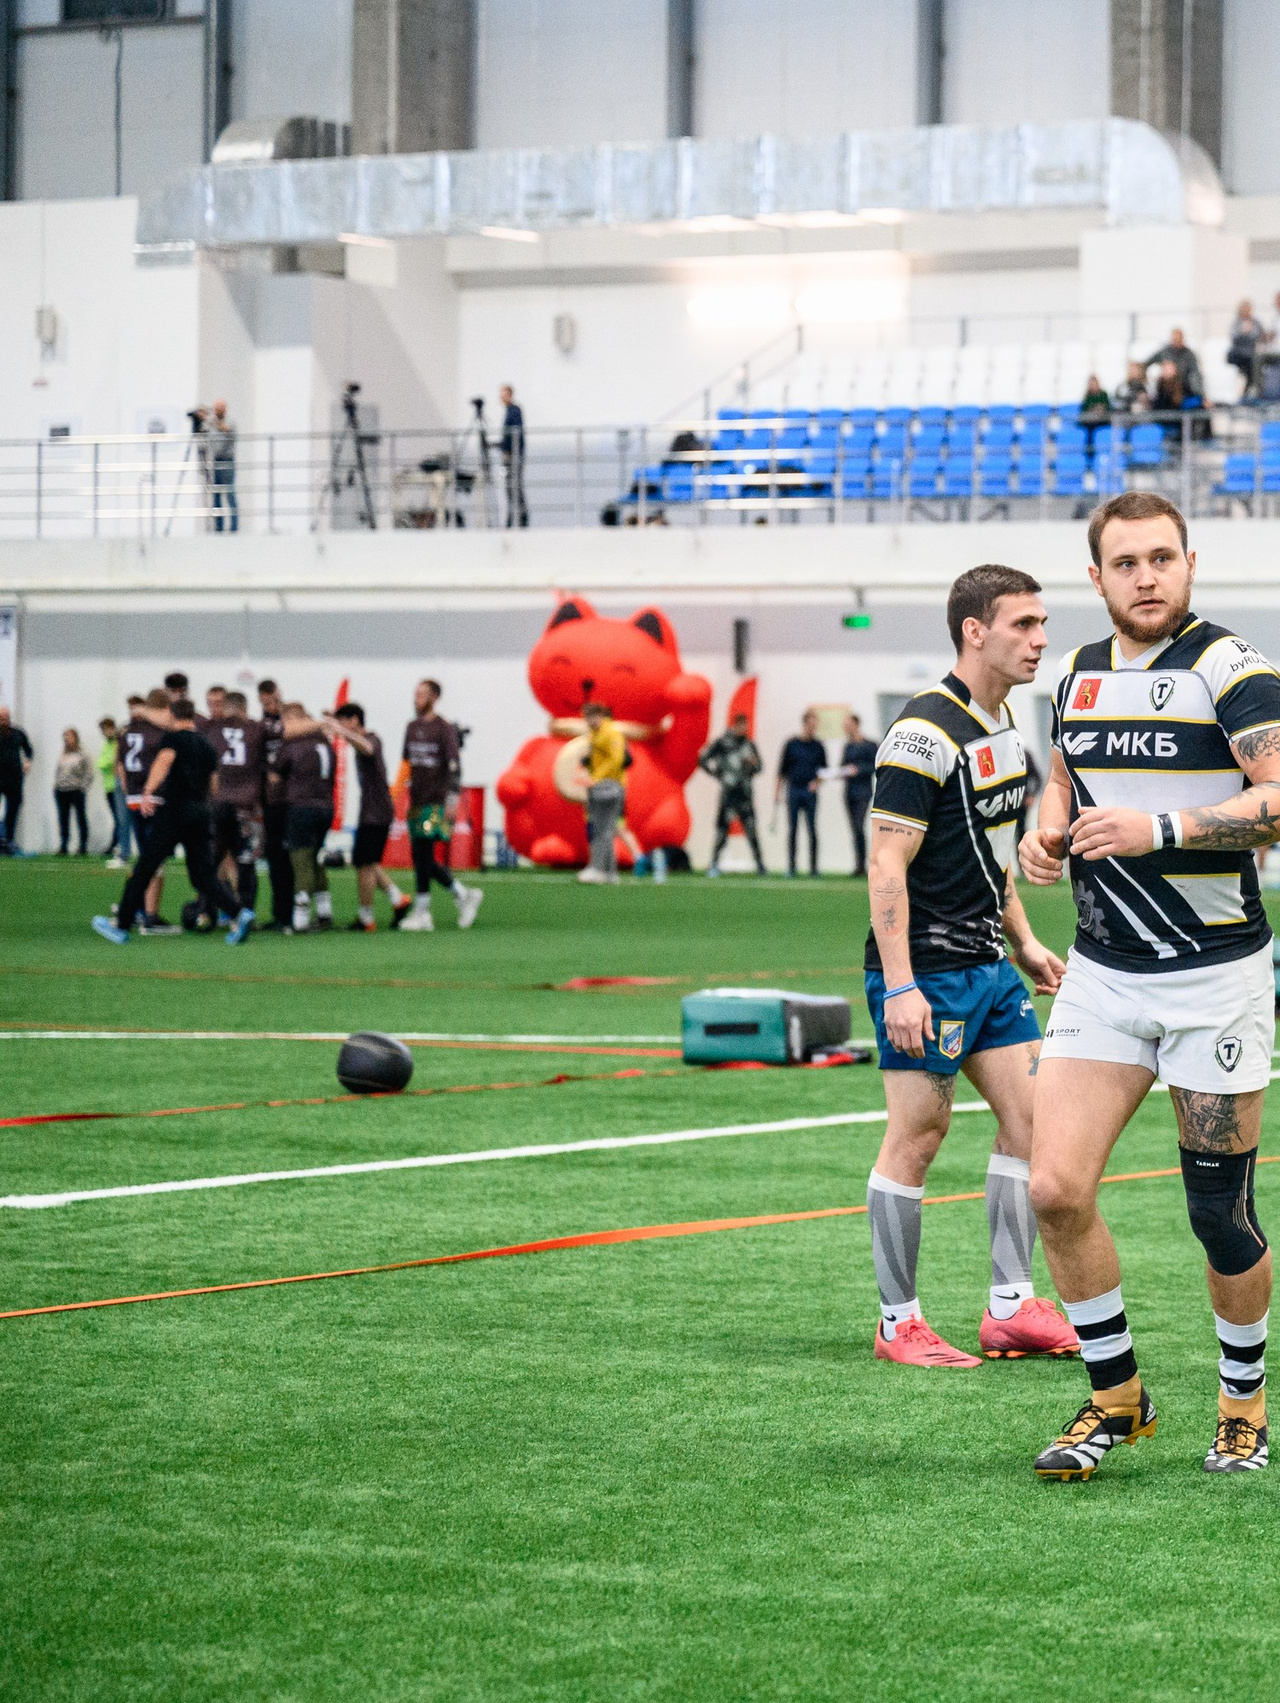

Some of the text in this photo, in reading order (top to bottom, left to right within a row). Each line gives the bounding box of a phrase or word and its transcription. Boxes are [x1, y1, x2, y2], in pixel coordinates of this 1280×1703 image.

[221, 727, 247, 766] 3
[892, 740, 936, 762] STORE
[894, 731, 939, 749] RUGBY
[1105, 731, 1179, 758] МКБ
[124, 732, 145, 773] 2
[1195, 1160, 1220, 1168] TARMAK
